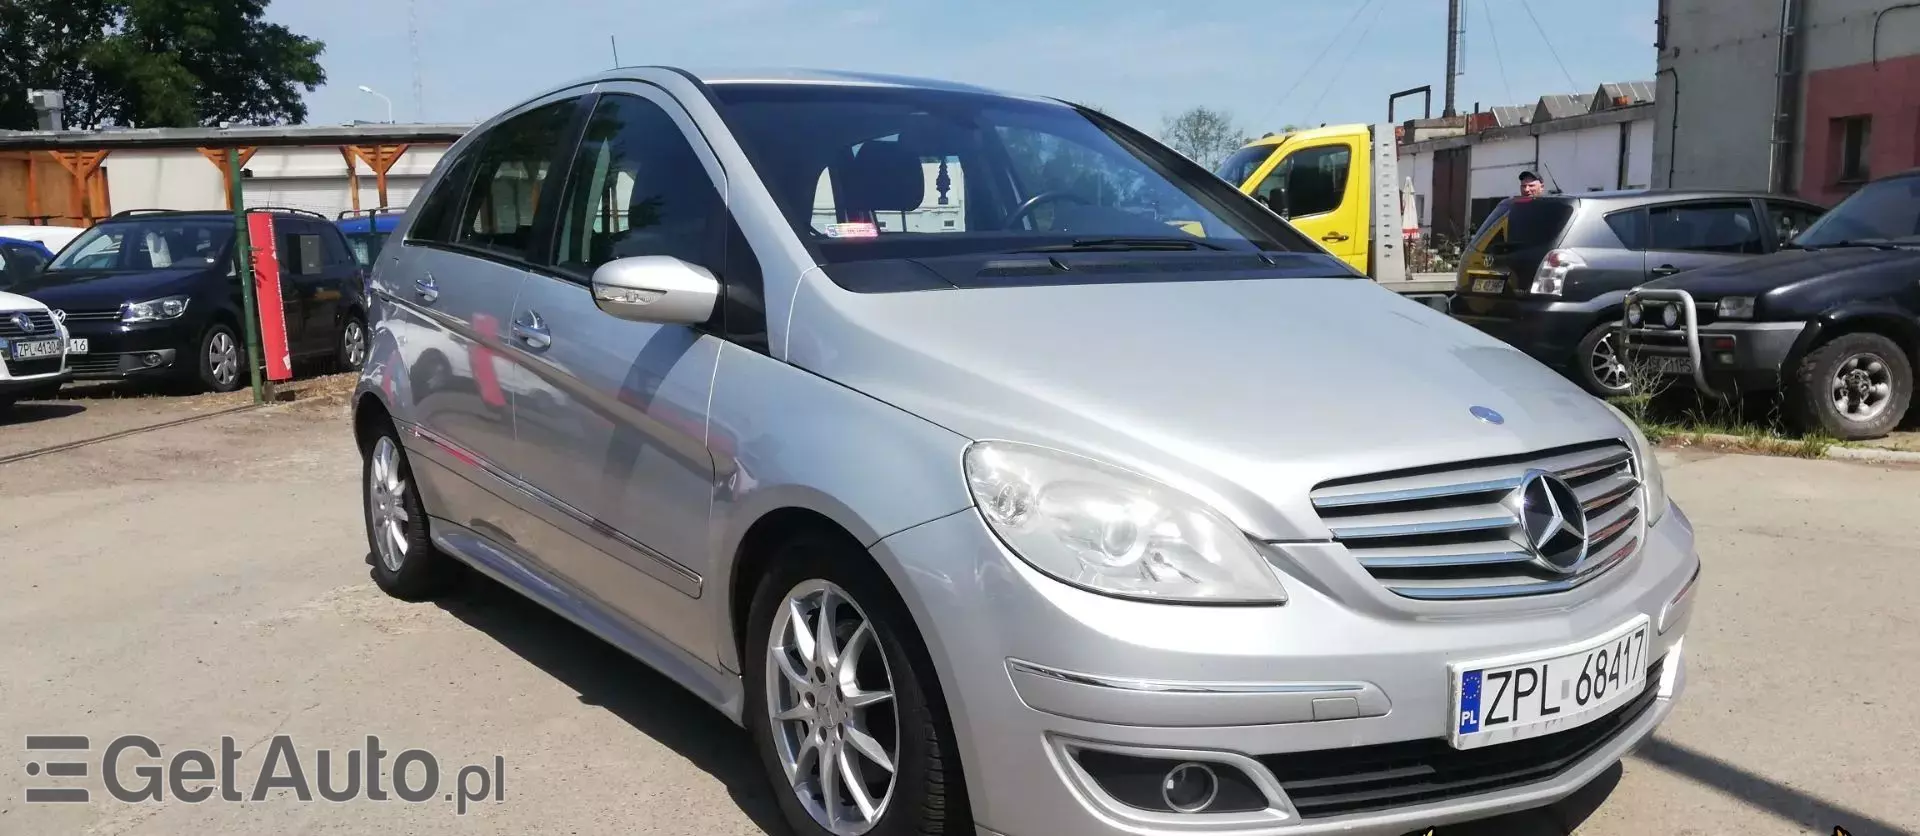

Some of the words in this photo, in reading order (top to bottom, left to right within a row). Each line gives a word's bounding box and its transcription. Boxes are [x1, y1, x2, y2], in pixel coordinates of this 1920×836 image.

[18, 343, 35, 357] ZPL
[1484, 664, 1560, 726] ZPL
[1575, 628, 1645, 706] 68417
[1462, 711, 1477, 726] PL
